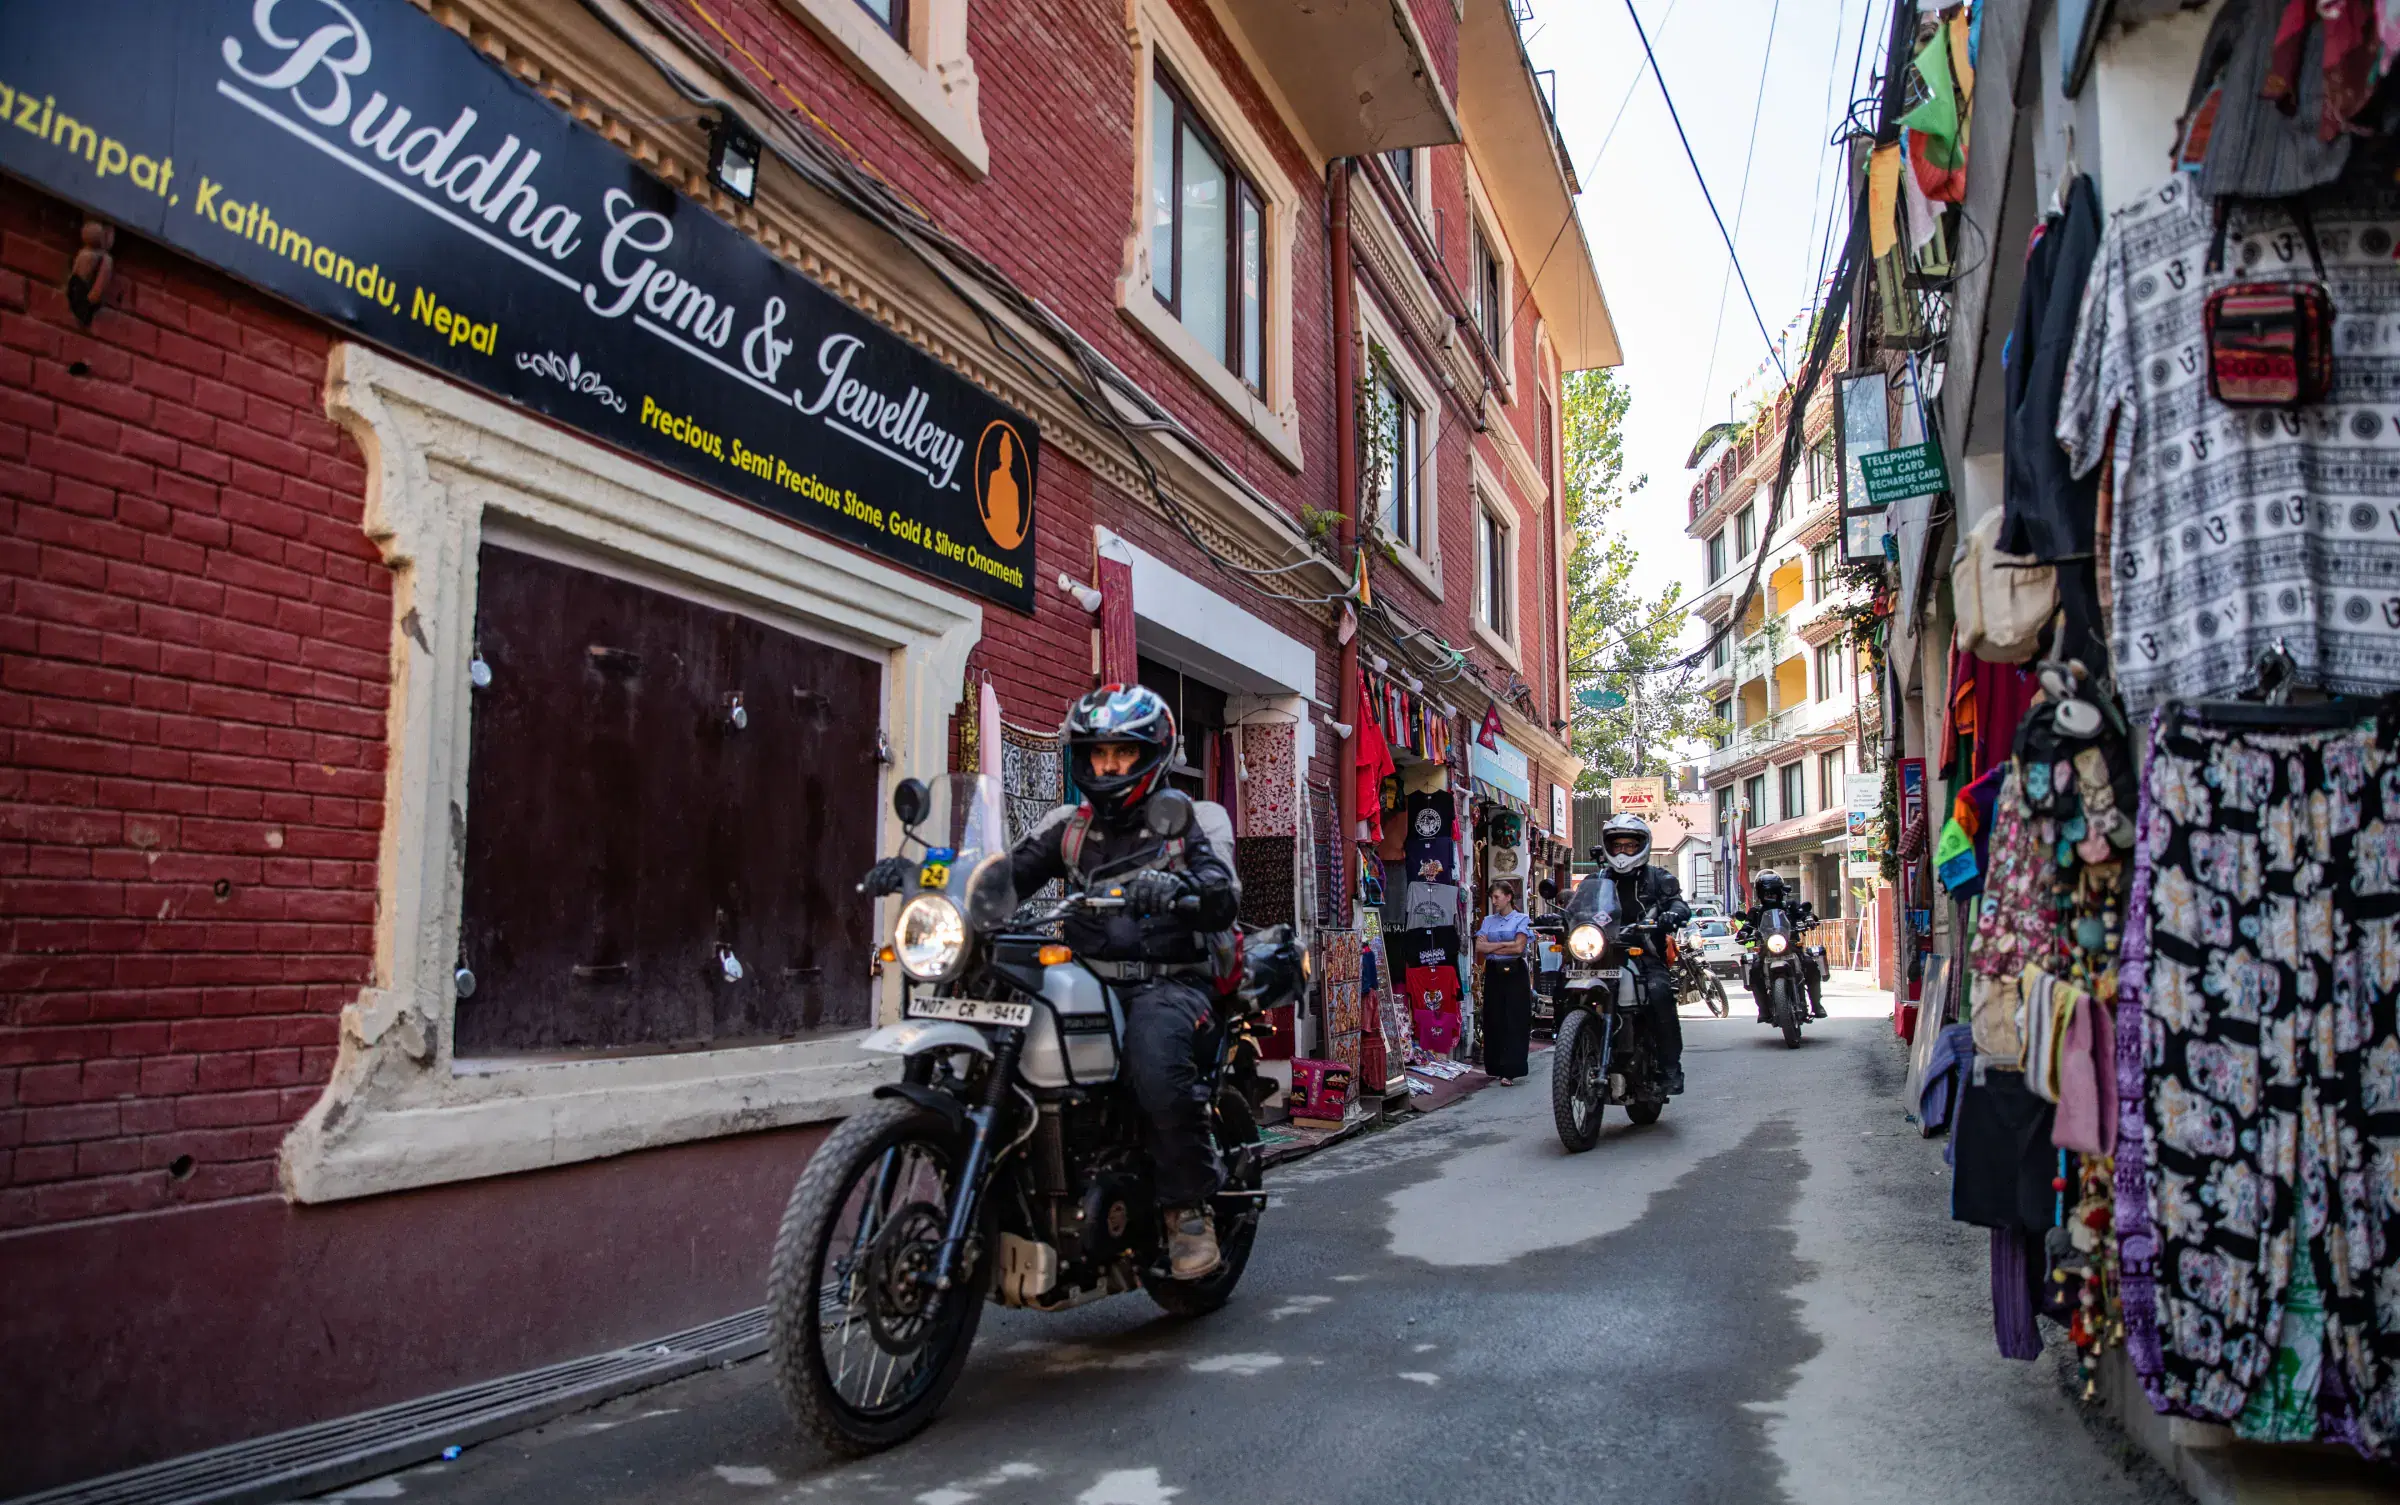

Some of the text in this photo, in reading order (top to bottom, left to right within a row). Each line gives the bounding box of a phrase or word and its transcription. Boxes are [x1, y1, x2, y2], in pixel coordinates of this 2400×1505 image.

[221, 0, 964, 491] Buddha Gems & Jewellery
[195, 176, 401, 315] Kathmandu,
[410, 286, 499, 356] Nepal
[1865, 446, 1927, 467] TELEPHONE
[1869, 468, 1941, 490] RECHARGE CARD
[1872, 459, 1926, 478] SIM CARD
[640, 394, 1024, 589] Precious, Semi Precious Stone, Gold & Silver Ornaments
[1620, 794, 1654, 804] TIBET
[924, 868, 945, 884] 24
[958, 1002, 978, 1017] CR
